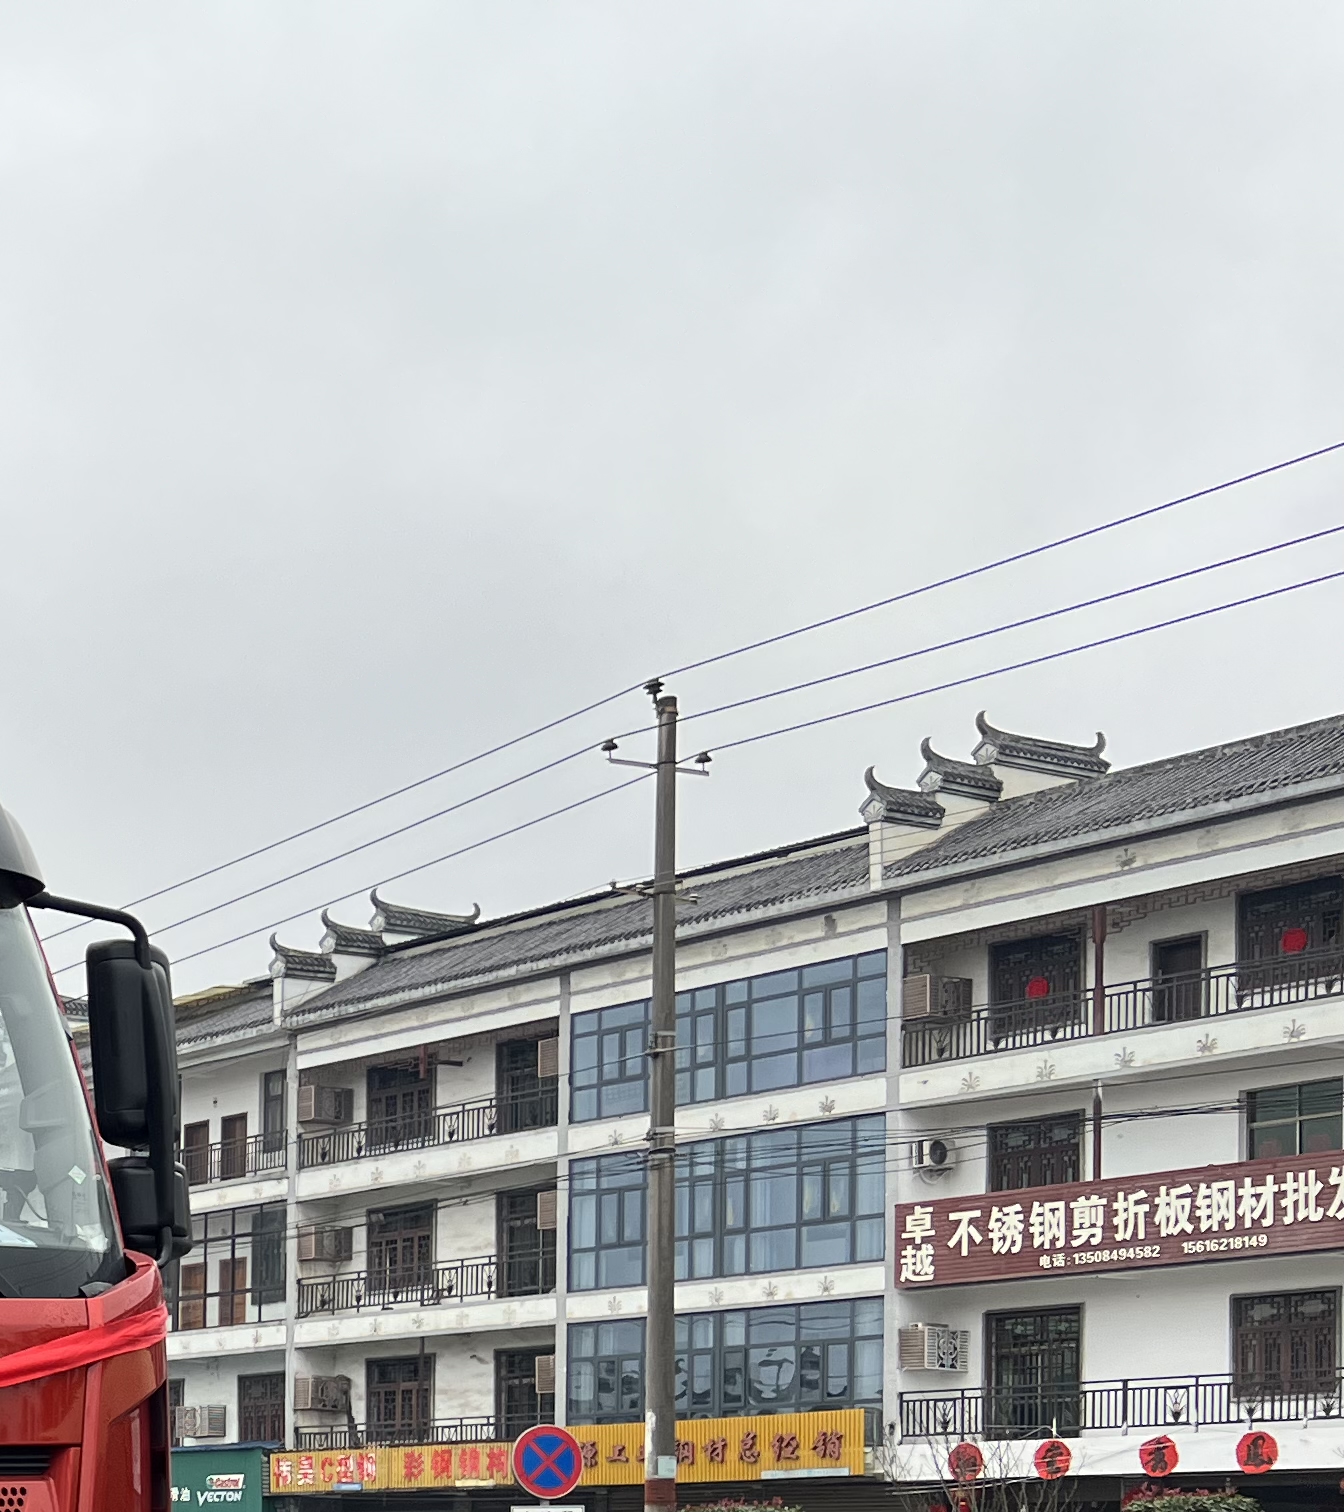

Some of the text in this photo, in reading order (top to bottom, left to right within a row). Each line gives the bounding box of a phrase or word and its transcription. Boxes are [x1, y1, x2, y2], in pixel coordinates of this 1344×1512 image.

[899, 1205, 937, 1283] 卓越
[1181, 1233, 1268, 1254] 15616218149
[196, 1490, 242, 1507] VECTON
